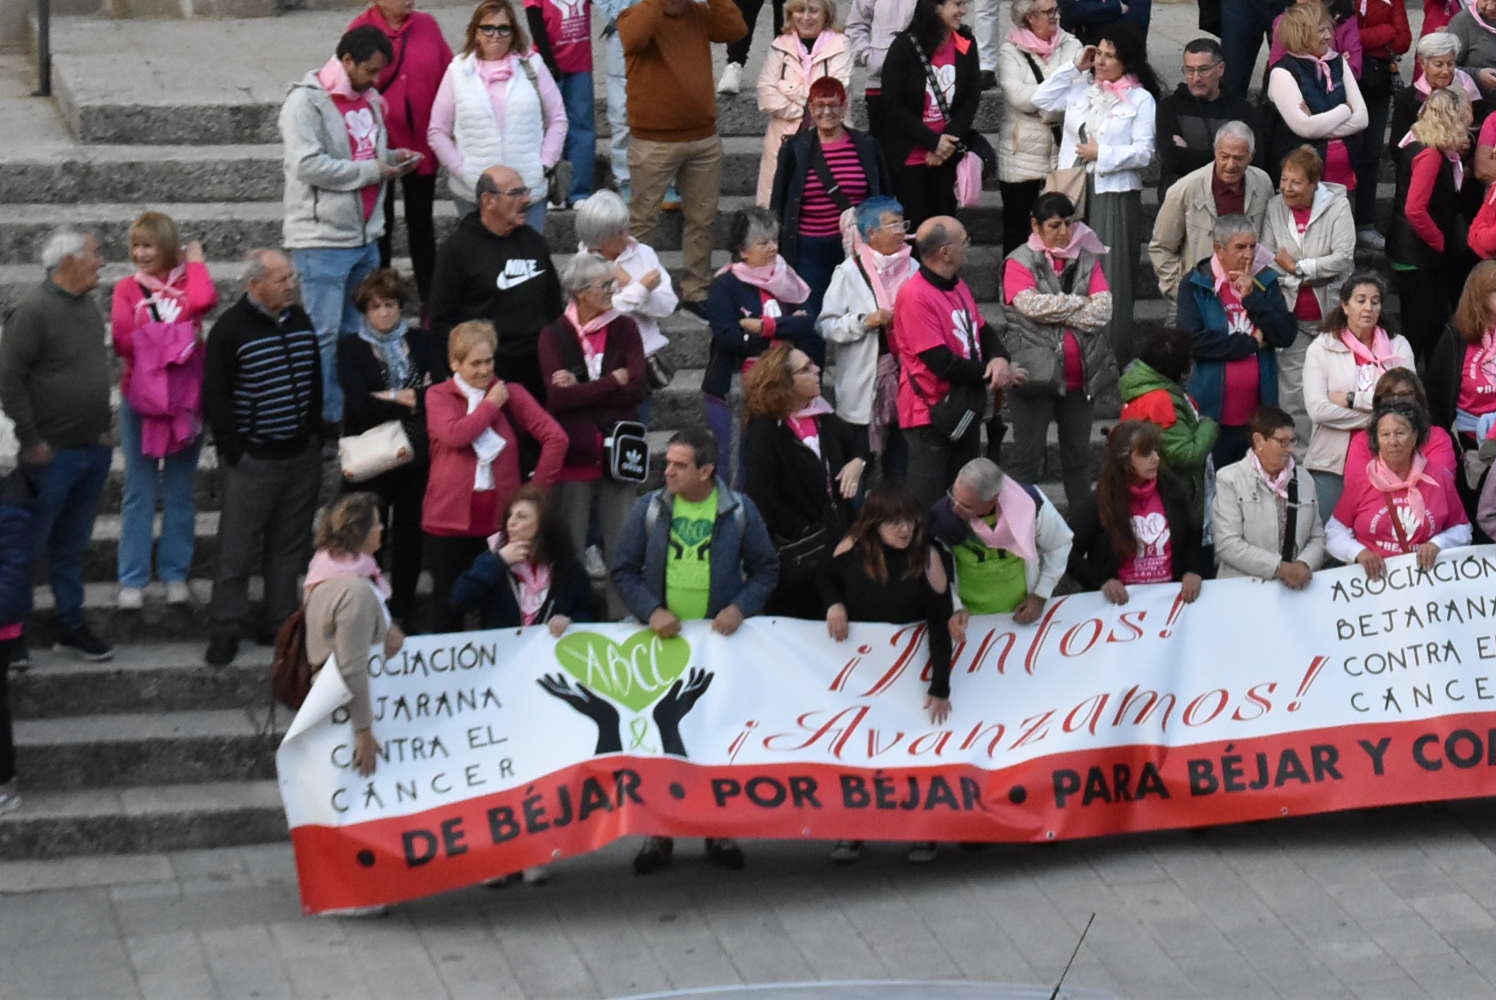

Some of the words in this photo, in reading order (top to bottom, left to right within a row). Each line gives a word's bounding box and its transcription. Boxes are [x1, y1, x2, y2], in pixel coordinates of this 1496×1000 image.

[367, 641, 498, 678] OCIACIÓN
[563, 634, 675, 697] ABCC
[1344, 639, 1463, 677] CONTRA
[331, 686, 503, 725] BJARANA
[727, 655, 1330, 762] ¡Avanzamos!
[467, 724, 509, 750] EL
[401, 817, 470, 869] DE
[486, 768, 647, 844] BÉJAR
[710, 775, 823, 809] POR
[838, 769, 988, 812] BÉJAR
[1051, 761, 1172, 809] PARA
[1186, 744, 1345, 797] BÉJAR
[1358, 736, 1393, 776] Y
